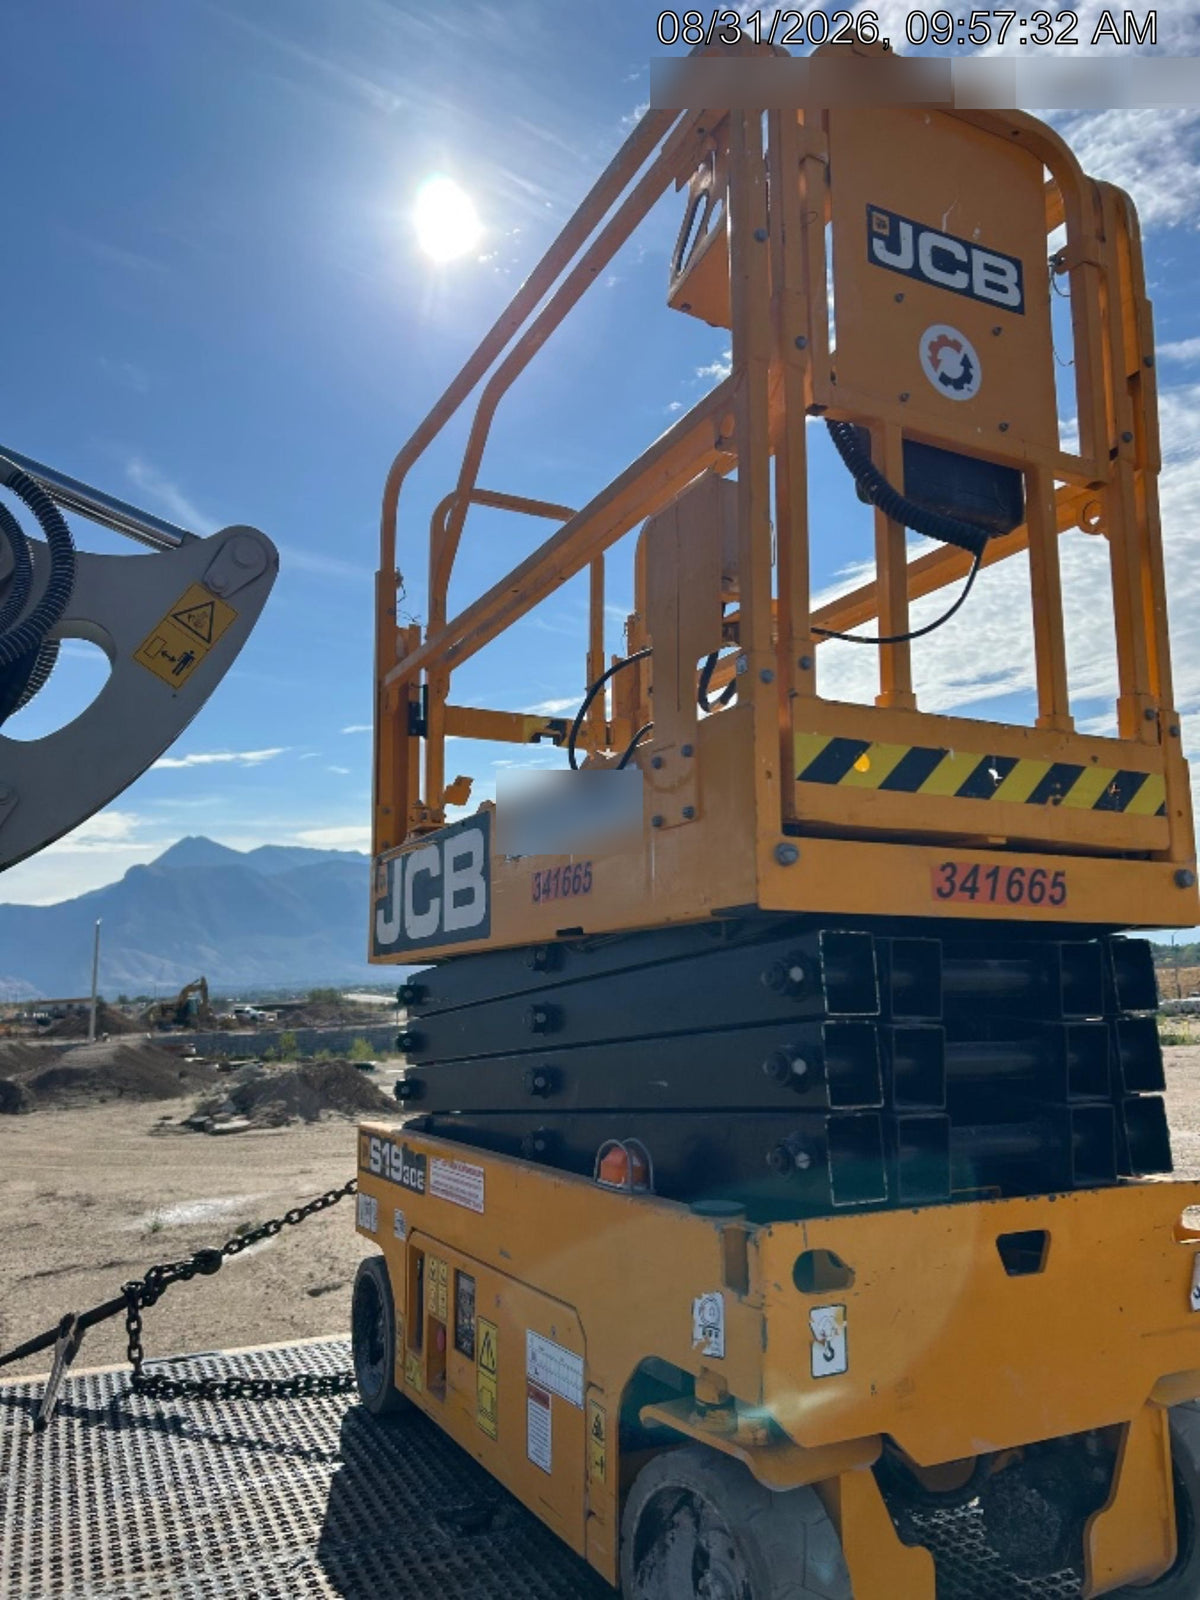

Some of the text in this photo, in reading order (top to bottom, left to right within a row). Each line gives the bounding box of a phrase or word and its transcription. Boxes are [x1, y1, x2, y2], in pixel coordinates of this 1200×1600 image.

[872, 220, 1022, 307] JCB
[375, 827, 487, 946] JCB
[532, 861, 593, 902] 341665
[936, 861, 1067, 906] 341665
